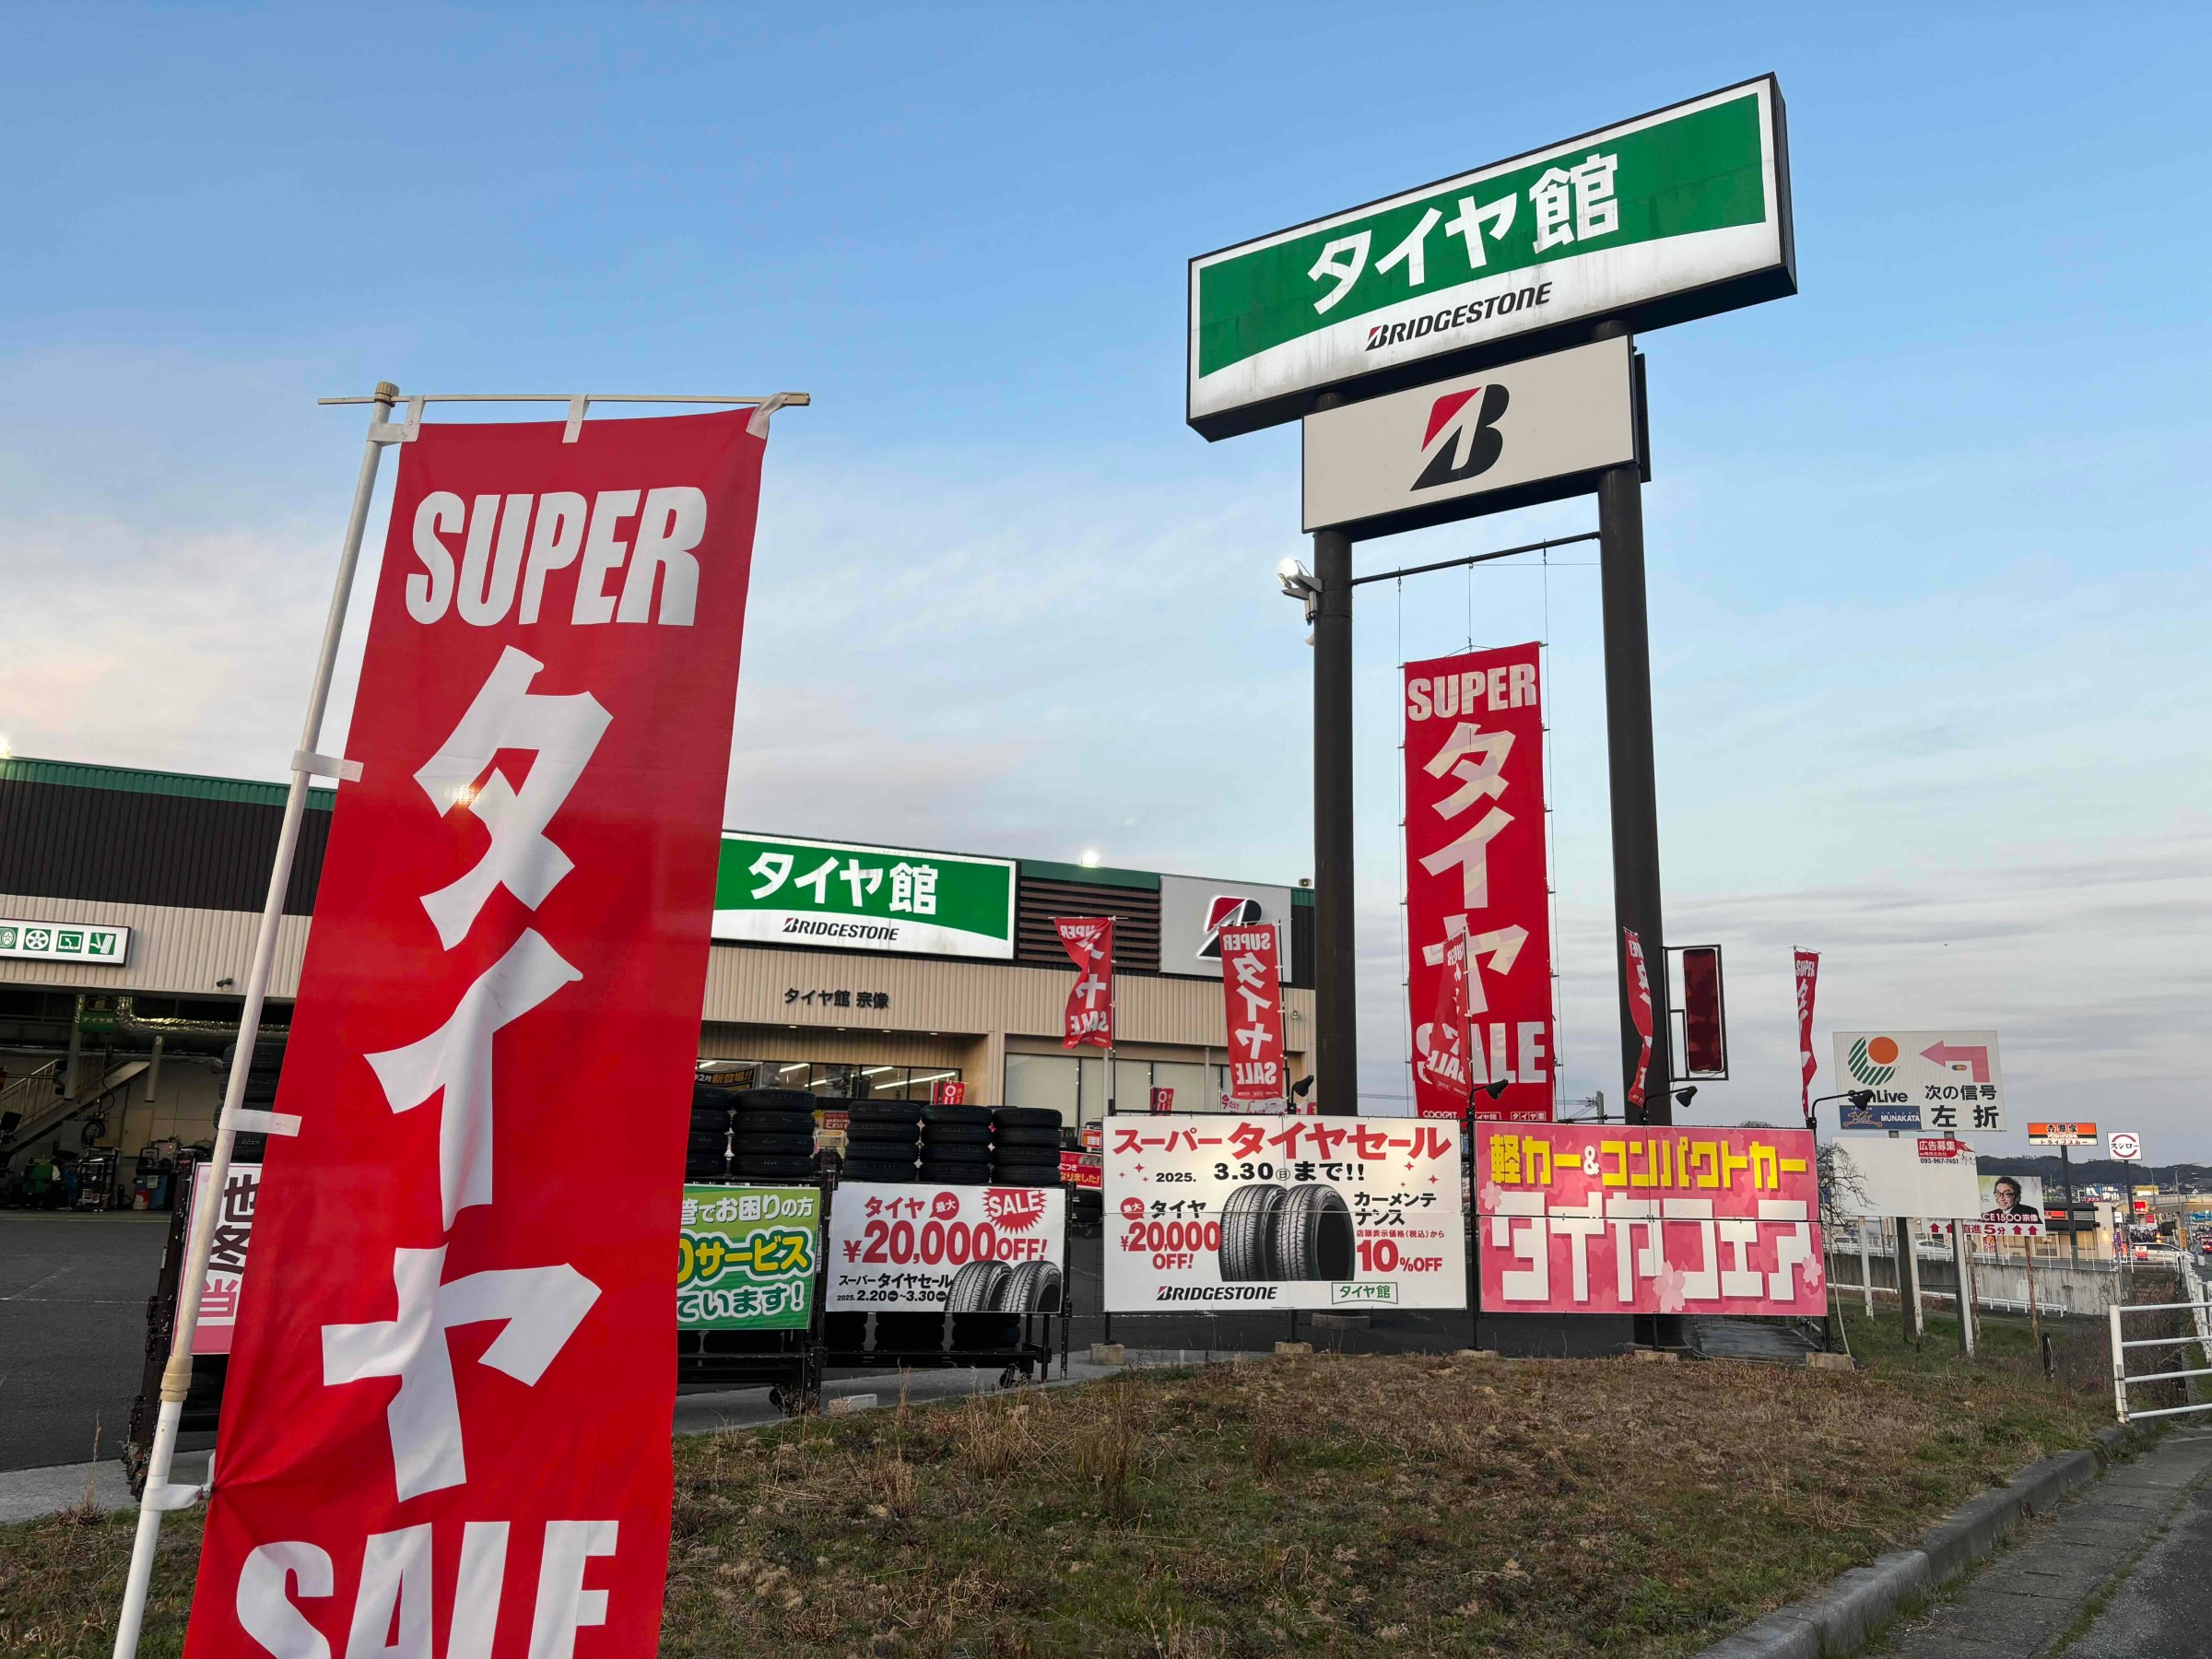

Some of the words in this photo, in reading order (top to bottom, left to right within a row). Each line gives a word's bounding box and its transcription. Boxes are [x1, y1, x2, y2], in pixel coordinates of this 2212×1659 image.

[1306, 152, 1619, 315] タイヤ館
[1365, 281, 1552, 352] BRIDGESTONE
[406, 486, 708, 628] SUPER
[1406, 663, 1536, 722] SUPER
[1418, 721, 1530, 1015] タイヤ
[747, 852, 938, 915] タイヤ館
[782, 917, 900, 941] BRIDGESTONE
[784, 988, 851, 1007] タイヤ館
[855, 991, 889, 1009] 宗像
[322, 643, 615, 1501] タイヤ
[1924, 1085, 1996, 1100] 次の信号
[1423, 1111, 1457, 1119] COCKPIT
[1880, 1114, 1921, 1123] MUNAKATA
[1112, 1122, 1453, 1160] スーパータイヤセール
[1919, 1140, 1956, 1151] 広告募集
[1156, 1172, 1196, 1182] 2025.
[864, 1195, 925, 1219] タイヤ
[935, 1198, 957, 1213] 最大
[988, 1190, 1043, 1218] SALE
[1150, 1199, 1207, 1219] タイヤ
[1354, 1192, 1437, 1207] カーメンテ
[1355, 1208, 1406, 1226] ナンス
[842, 1219, 996, 1265] ¥20,000
[996, 1237, 1048, 1261] OFF!
[1121, 1221, 1221, 1252] ¥20,000
[1152, 1253, 1194, 1270] OFF!
[839, 1272, 955, 1289] スーパータイヤセール
[1156, 1286, 1277, 1301] BRIDGESTONE
[1339, 1285, 1391, 1299] タイヤ館
